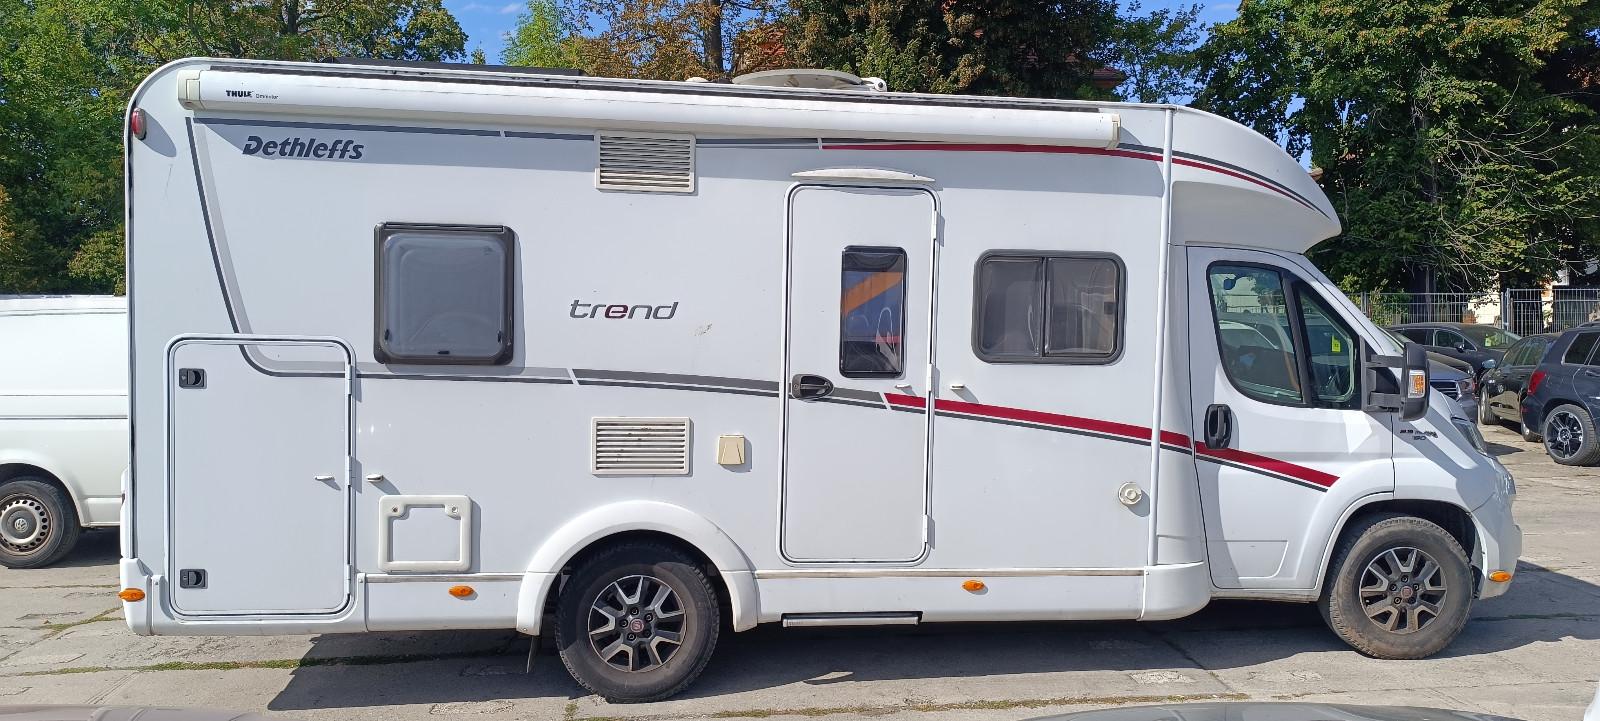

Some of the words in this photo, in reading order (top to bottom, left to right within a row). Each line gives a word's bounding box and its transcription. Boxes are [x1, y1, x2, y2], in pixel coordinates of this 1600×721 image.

[226, 90, 252, 98] THULE
[242, 135, 364, 159] Dethleffs
[569, 299, 679, 320] trend
